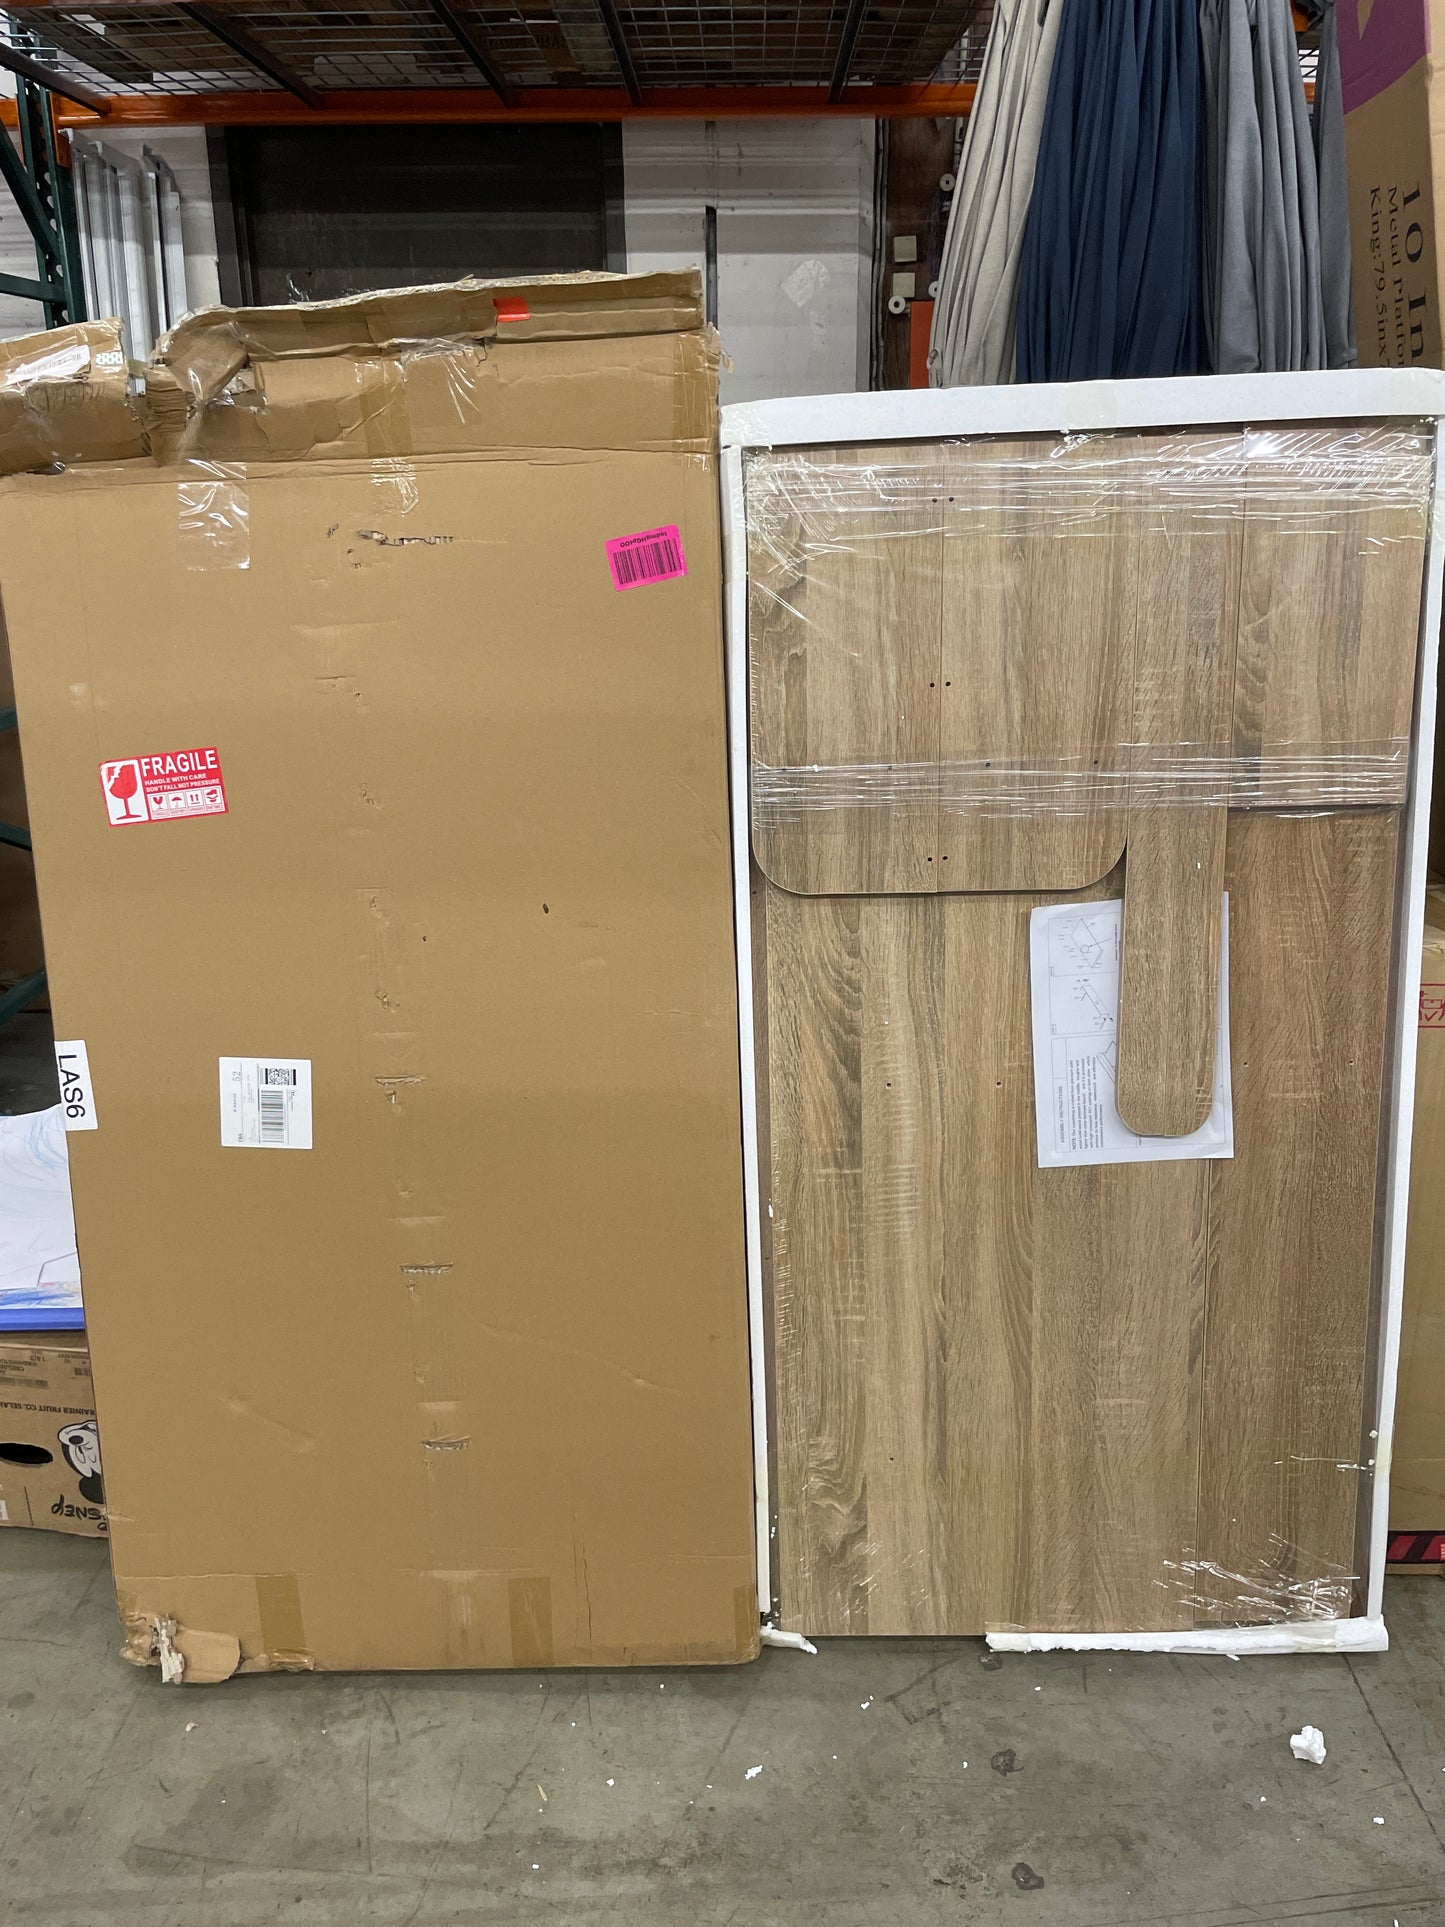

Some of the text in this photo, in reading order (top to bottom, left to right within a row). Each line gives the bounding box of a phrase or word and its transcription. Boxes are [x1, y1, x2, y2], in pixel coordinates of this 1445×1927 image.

[1387, 184, 1401, 267] Metal
[1402, 181, 1424, 264] 10
[141, 750, 218, 777] FRAGILE
[145, 773, 207, 786] HANDLE WITH CARE
[146, 778, 220, 793] DON'T FALL NOT PRESSURE
[58, 1054, 86, 1119] LAS6
[24, 1402, 37, 1411] CO.
[39, 1404, 61, 1413] FRUIT
[63, 1406, 96, 1416] RAINIER
[51, 1493, 108, 1532] SNEY
